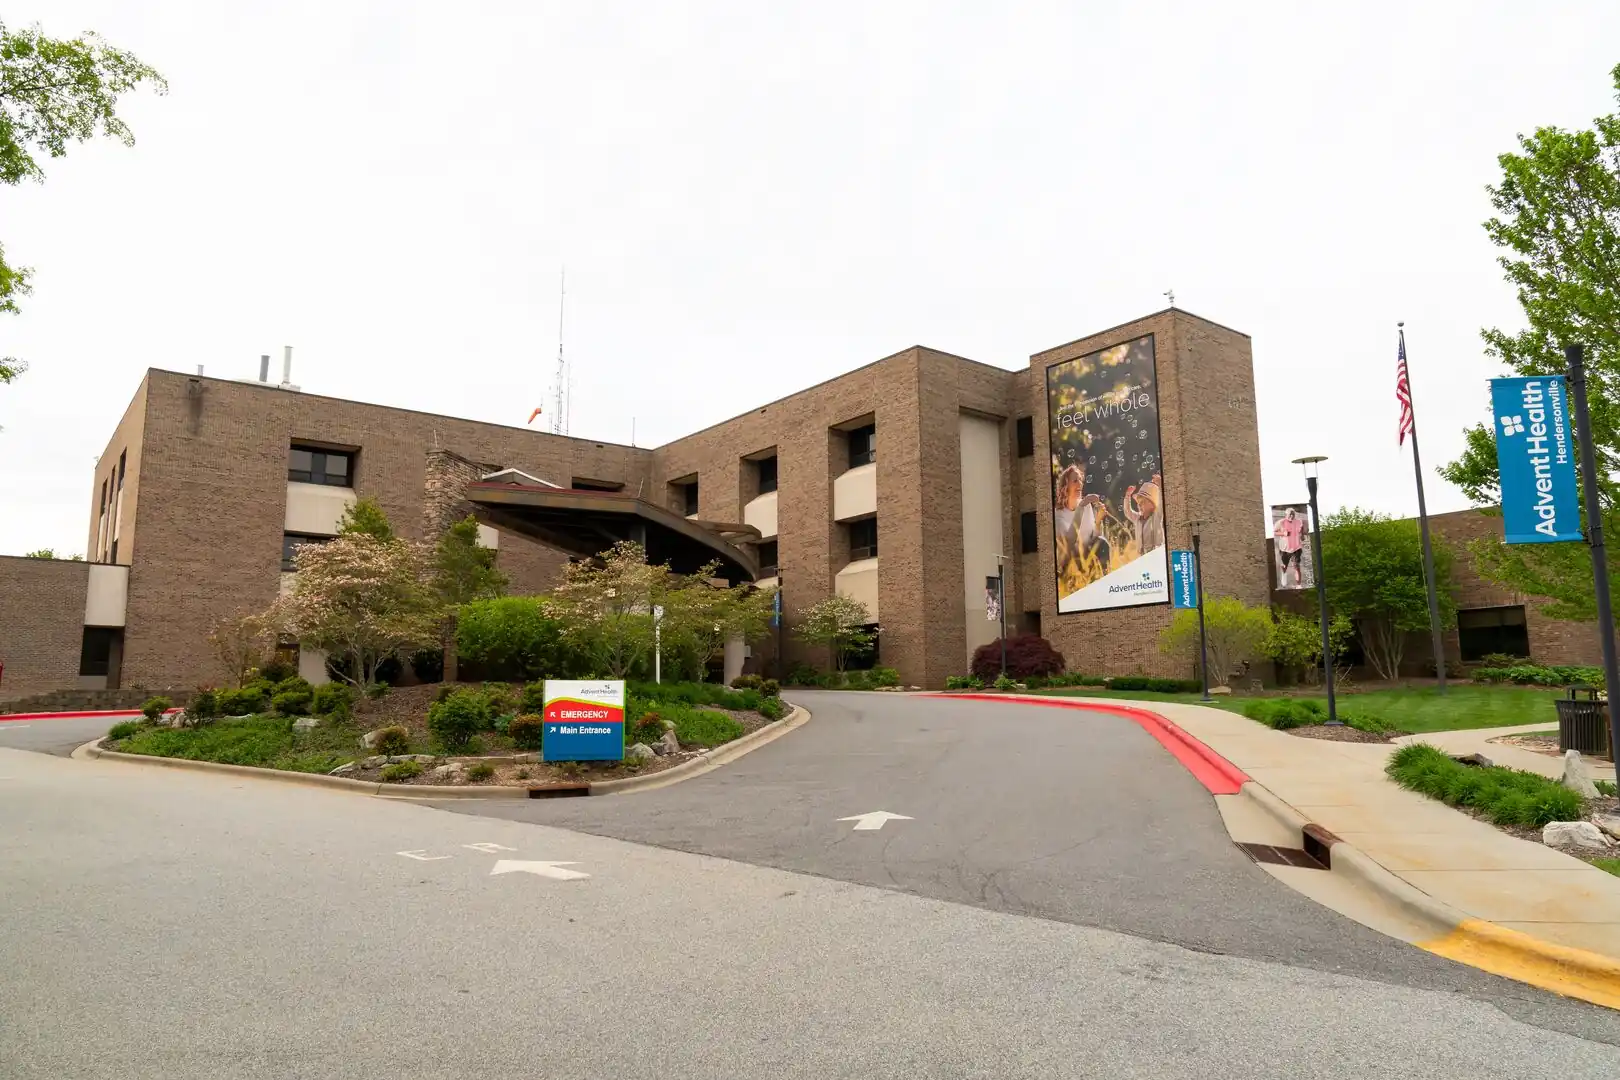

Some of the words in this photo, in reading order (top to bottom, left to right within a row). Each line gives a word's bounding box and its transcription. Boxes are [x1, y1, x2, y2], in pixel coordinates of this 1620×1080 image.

[1056, 406, 1090, 429] feel
[1094, 392, 1150, 419] whole
[1549, 380, 1567, 464] Hendersonville
[1521, 381, 1558, 537] AdventHealth
[1109, 580, 1163, 593] AdventHealth
[1180, 552, 1190, 607] AdventHealth
[560, 710, 609, 719] EMERGENCY
[560, 726, 578, 734] Main
[579, 726, 611, 734] Entrance
